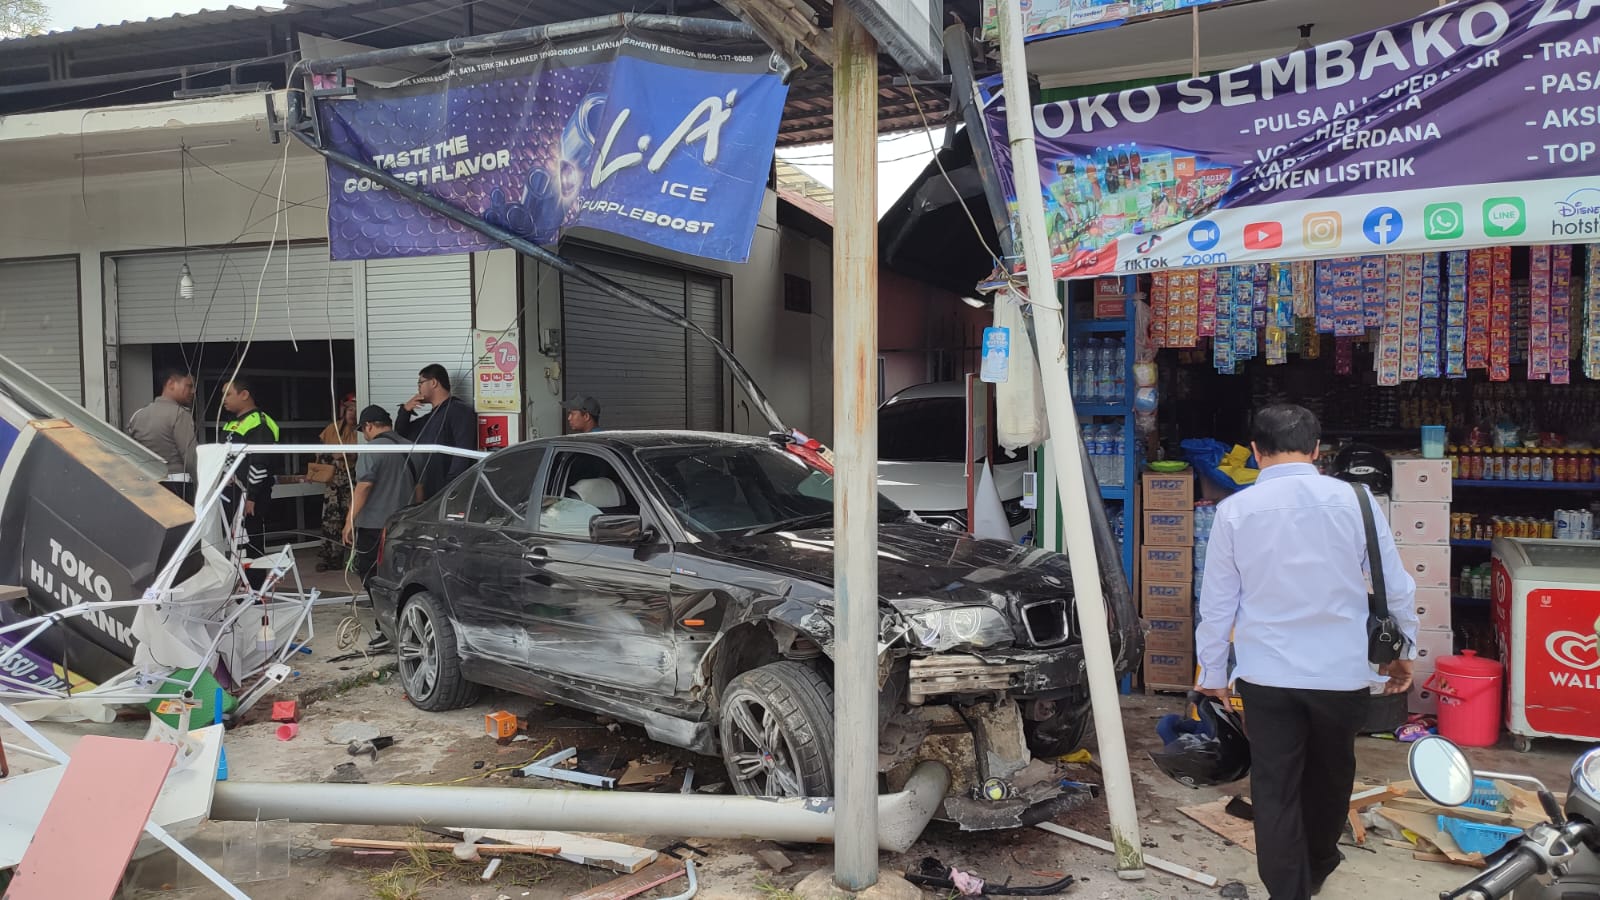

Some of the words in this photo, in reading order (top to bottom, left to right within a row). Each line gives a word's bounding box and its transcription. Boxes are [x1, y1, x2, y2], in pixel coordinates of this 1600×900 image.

[510, 54, 538, 65] KANKER
[1033, 85, 1161, 138] OKO
[1177, 0, 1509, 114] SEMBAKO
[1254, 107, 1328, 136] PULSA
[1542, 106, 1600, 130] AKS
[373, 146, 431, 170] TASTE
[435, 135, 469, 160] THE
[1543, 141, 1596, 164] TOP
[431, 149, 511, 183] FLAVOR
[1326, 157, 1416, 184] LISTRIK
[661, 180, 708, 202] ICE
[1493, 211, 1516, 219] LINE
[1551, 218, 1600, 235] hotst
[1125, 256, 1168, 270] TikTok
[1183, 252, 1227, 266] zoom
[498, 348, 508, 364] 7
[49, 537, 113, 602] TOKO
